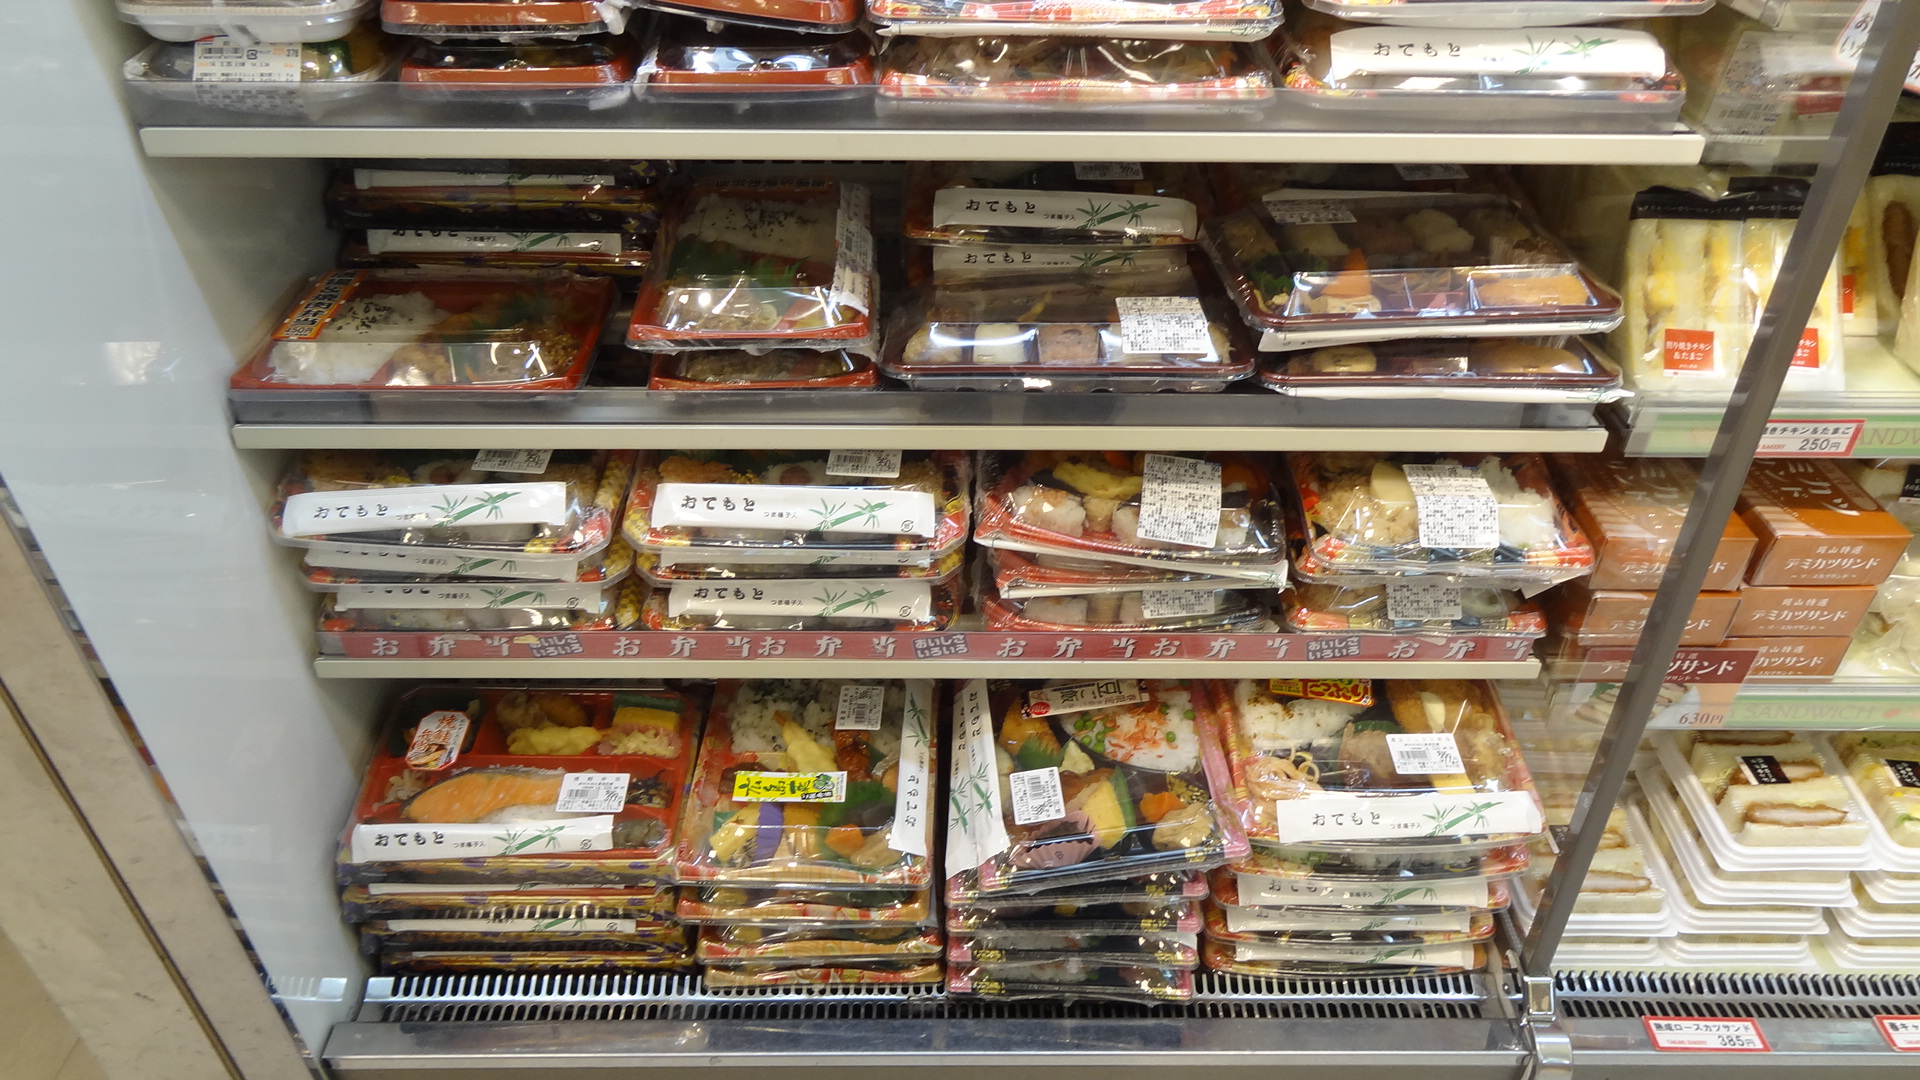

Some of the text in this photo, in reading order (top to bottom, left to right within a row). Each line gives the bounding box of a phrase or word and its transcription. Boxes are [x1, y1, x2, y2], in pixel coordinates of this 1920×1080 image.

[1373, 42, 1461, 57] おてもと
[965, 199, 1036, 214] おてもと
[964, 252, 1032, 265] おてもと
[1799, 438, 1841, 451] 250円
[681, 495, 756, 512] おてもと
[313, 503, 388, 519] おてもと
[395, 512, 431, 521] つま入
[1785, 557, 1881, 570] デミカツサンド
[693, 587, 764, 600] おてもと
[1751, 609, 1849, 622] デミカツサンド
[914, 634, 966, 648] おいしさ
[1308, 637, 1360, 650] おいしさ
[532, 644, 584, 657] いろいろ
[917, 645, 968, 658] いろいろ
[1309, 646, 1360, 660] いろいろ
[968, 691, 981, 737] おてもと
[1679, 711, 1724, 724] 630円
[1743, 703, 1875, 720] SANDWICH
[905, 775, 919, 827] おてもと
[1312, 811, 1381, 826] おてもと
[374, 831, 445, 847] おてもと
[1718, 1035, 1756, 1047] 385円
